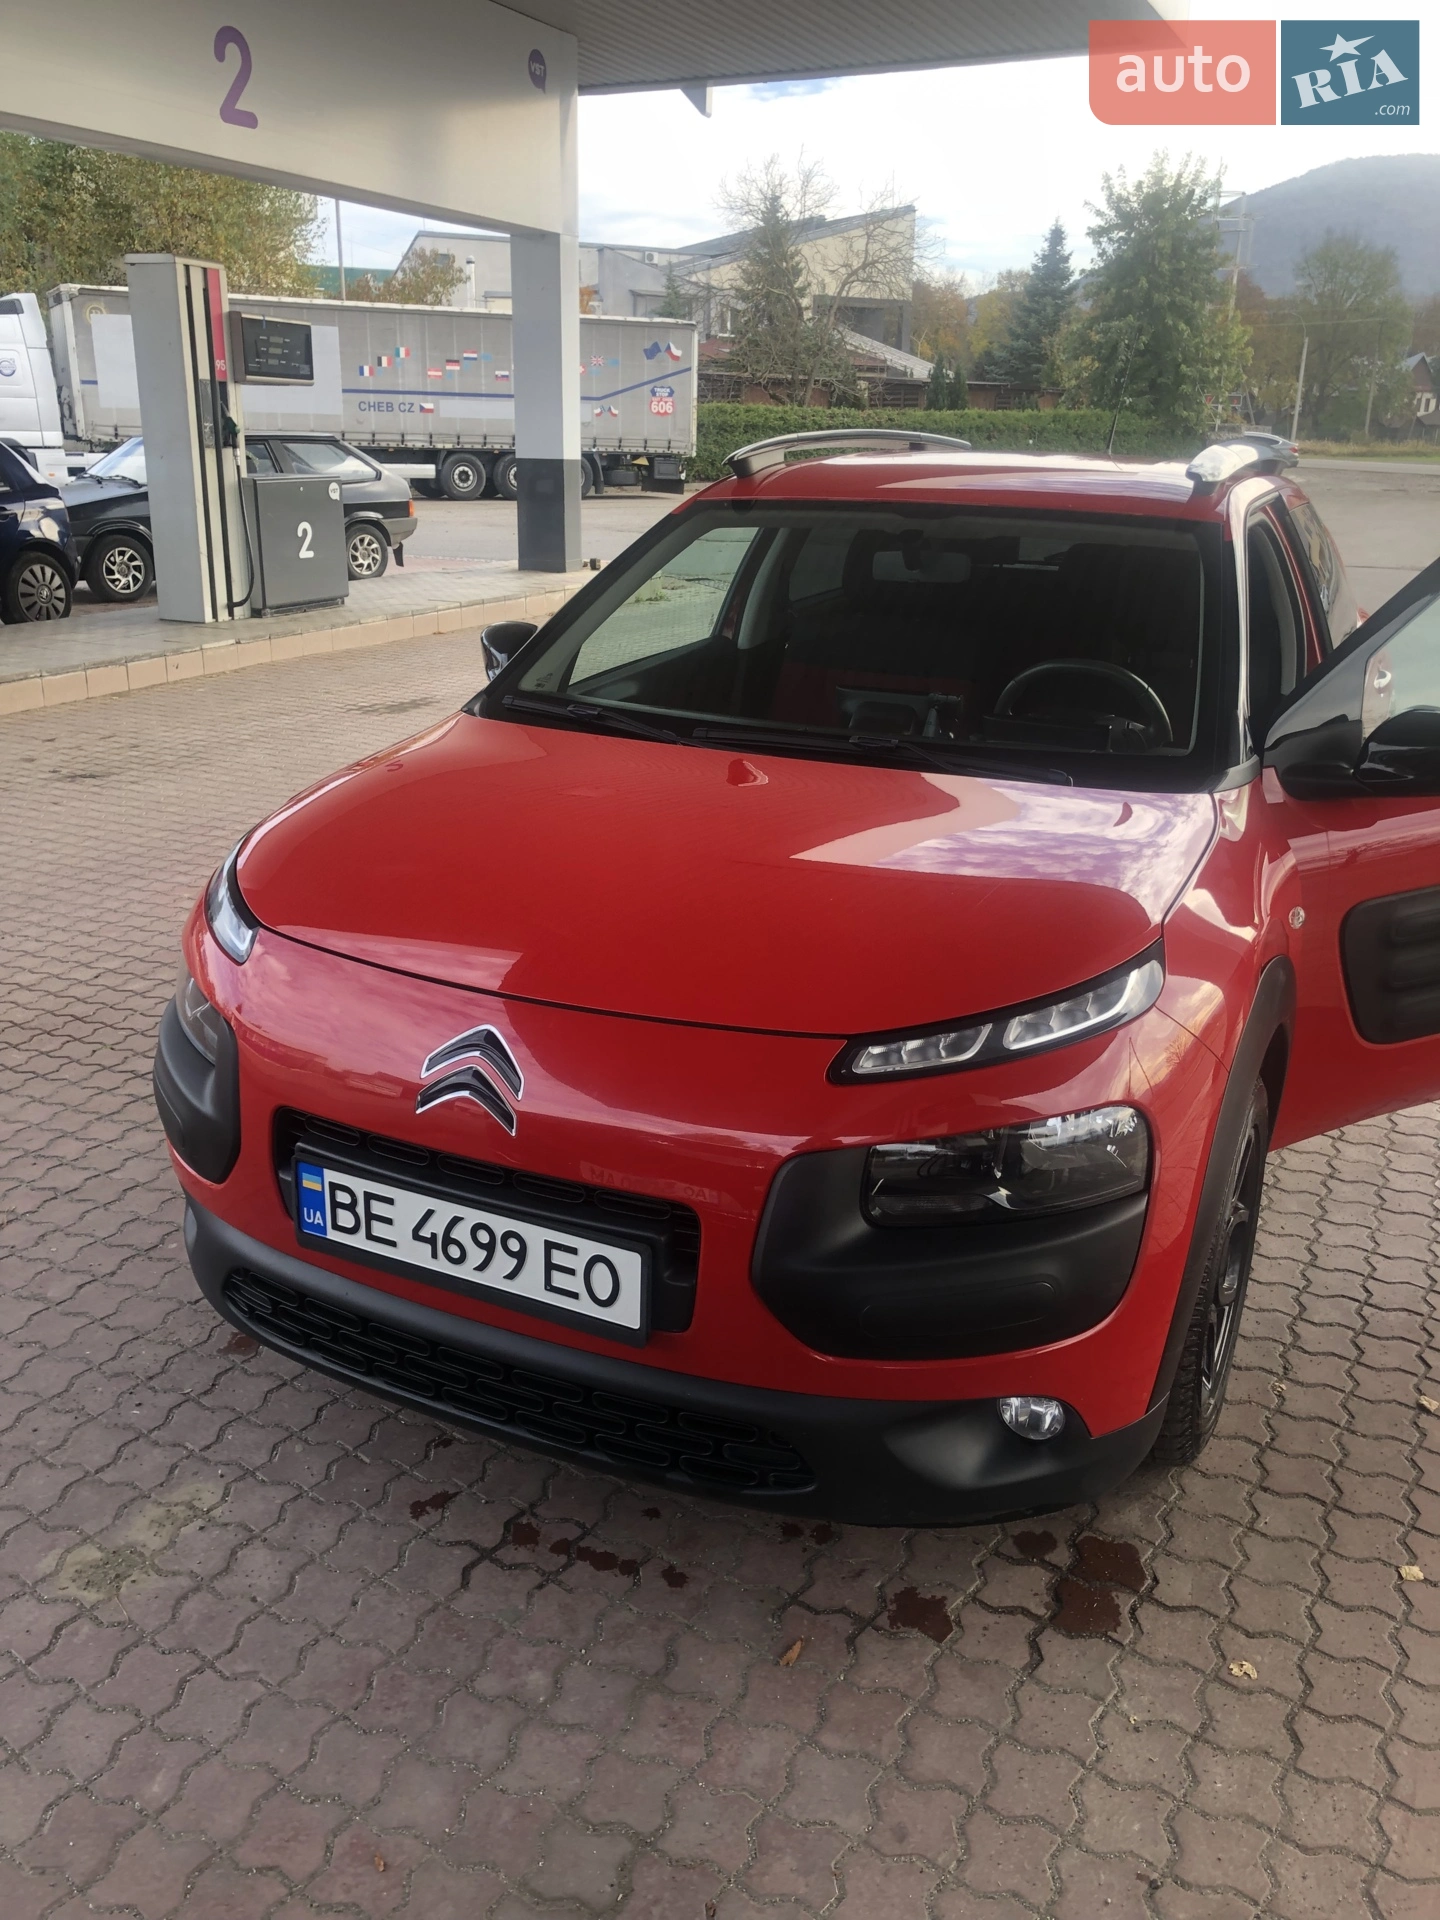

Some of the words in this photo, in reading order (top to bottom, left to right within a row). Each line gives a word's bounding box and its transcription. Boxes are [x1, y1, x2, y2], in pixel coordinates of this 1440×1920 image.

[213, 25, 258, 129] 2
[530, 61, 545, 77] VST
[215, 359, 226, 371] 95
[358, 401, 394, 413] CHEB
[398, 402, 415, 413] CZ
[651, 401, 673, 413] 606
[296, 520, 314, 559] 2
[303, 1207, 324, 1227] UA
[328, 1180, 398, 1248] BE
[411, 1207, 528, 1281] 4699
[543, 1239, 620, 1308] EO
